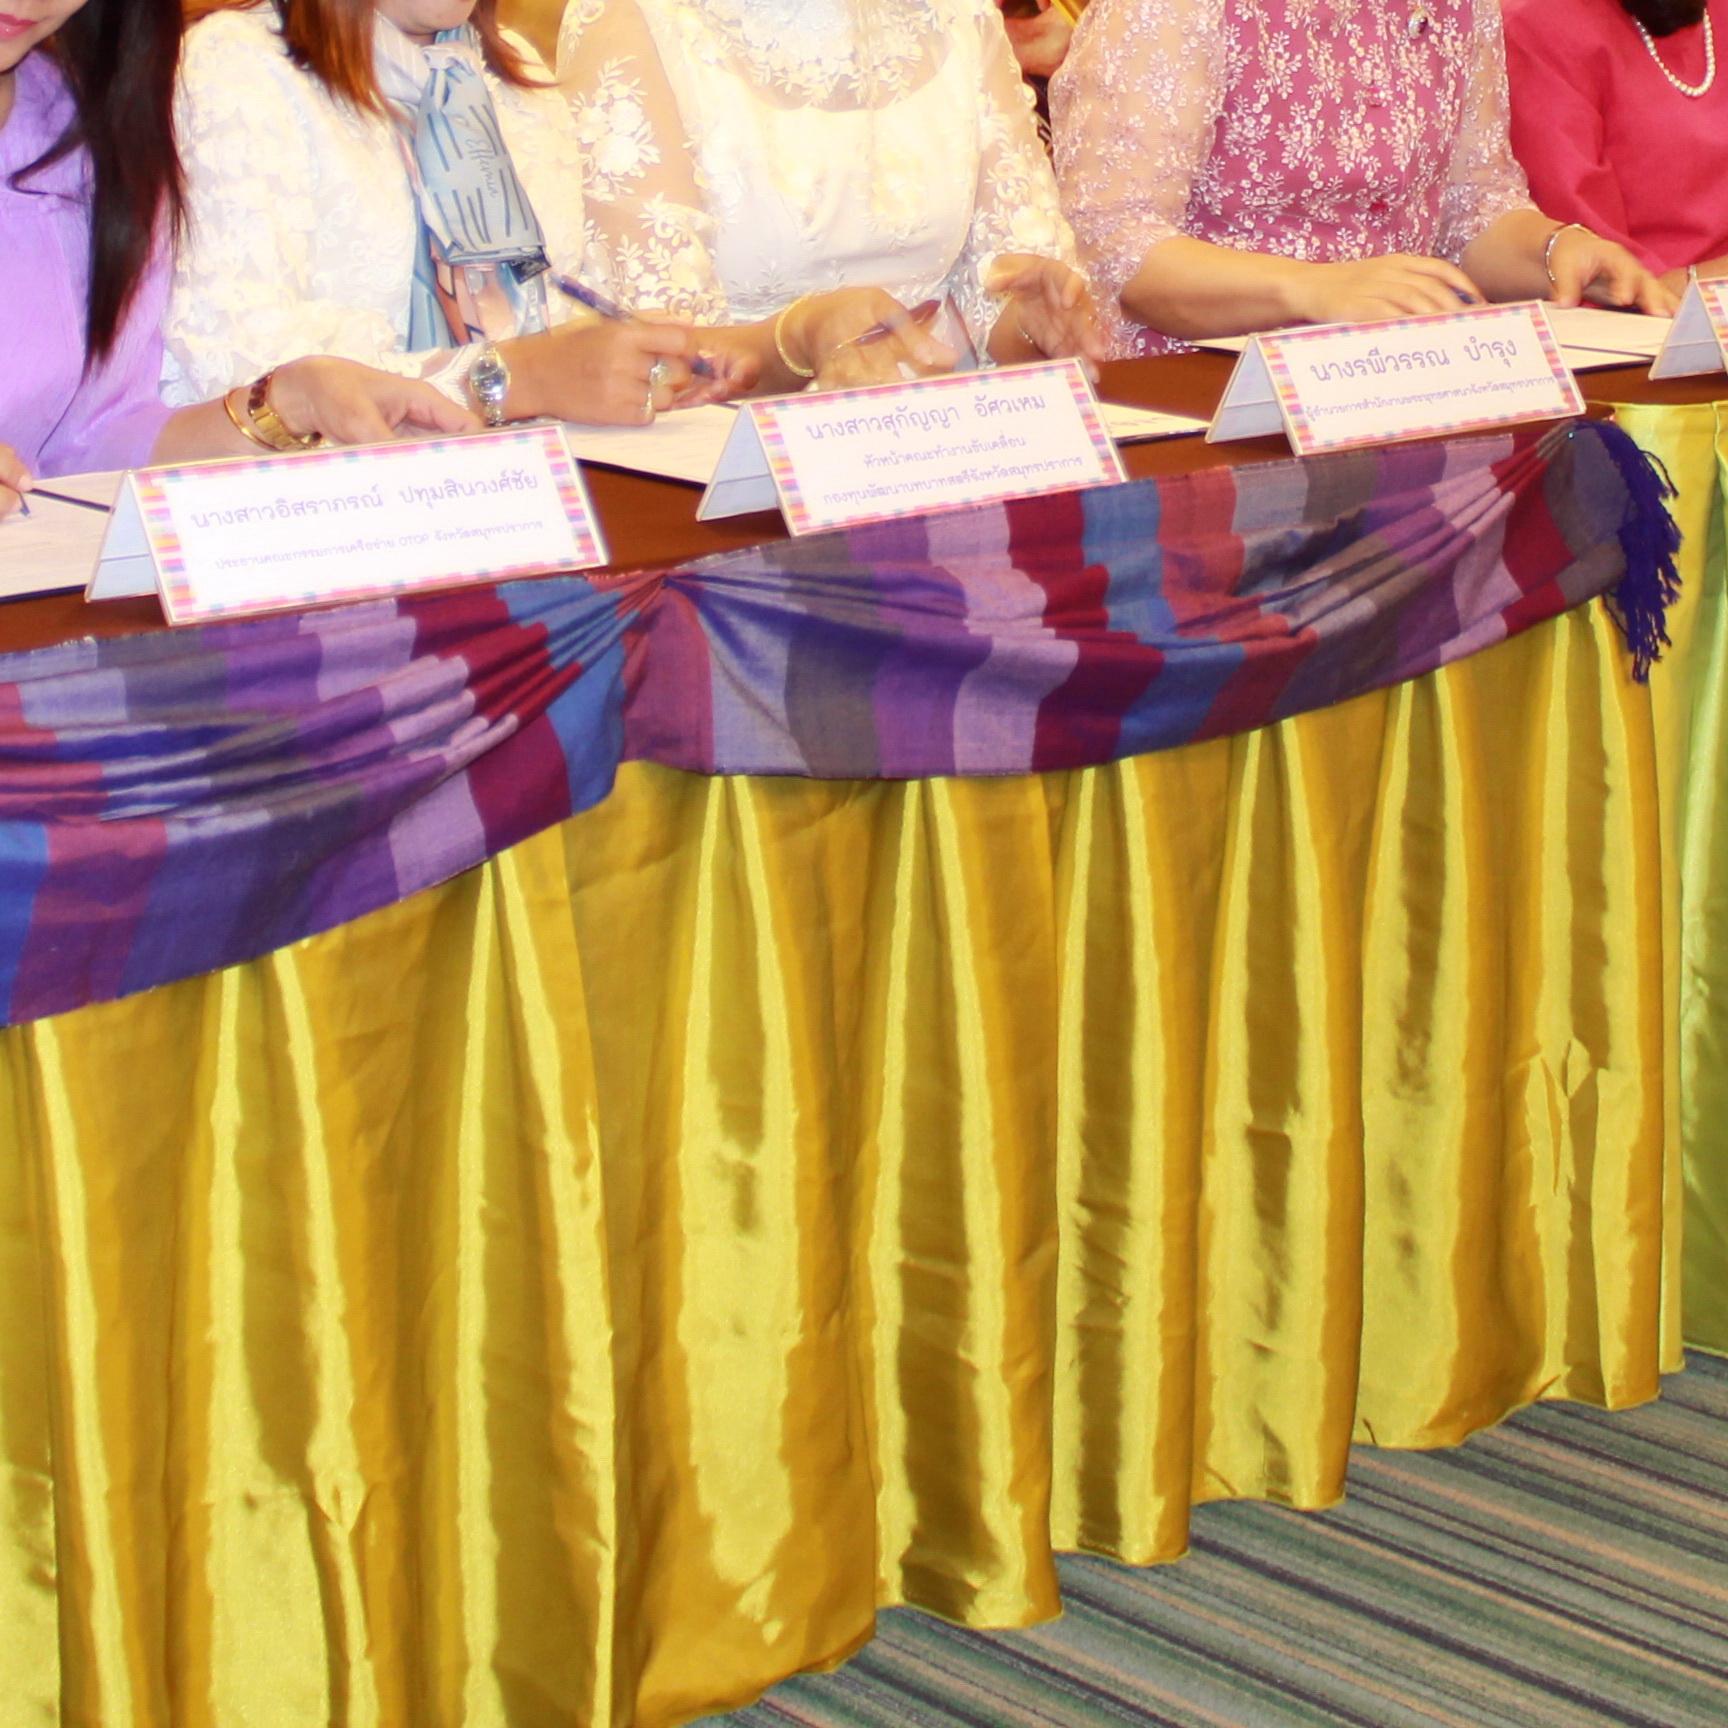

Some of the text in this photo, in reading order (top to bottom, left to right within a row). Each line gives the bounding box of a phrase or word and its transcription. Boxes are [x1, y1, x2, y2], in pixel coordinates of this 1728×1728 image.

[1310, 335, 1518, 383] นางรพีวรรณ บำรุง
[806, 392, 1047, 441] นางสาวสุกัญญา อัศวเหม
[863, 430, 1028, 470] หัวหน้าคณะทำงานขับเคลื่อน
[190, 467, 540, 530] นางสาวอิสราภรณ์ ปทุมสินวงศ์ชัย
[398, 532, 431, 548] OTOP
